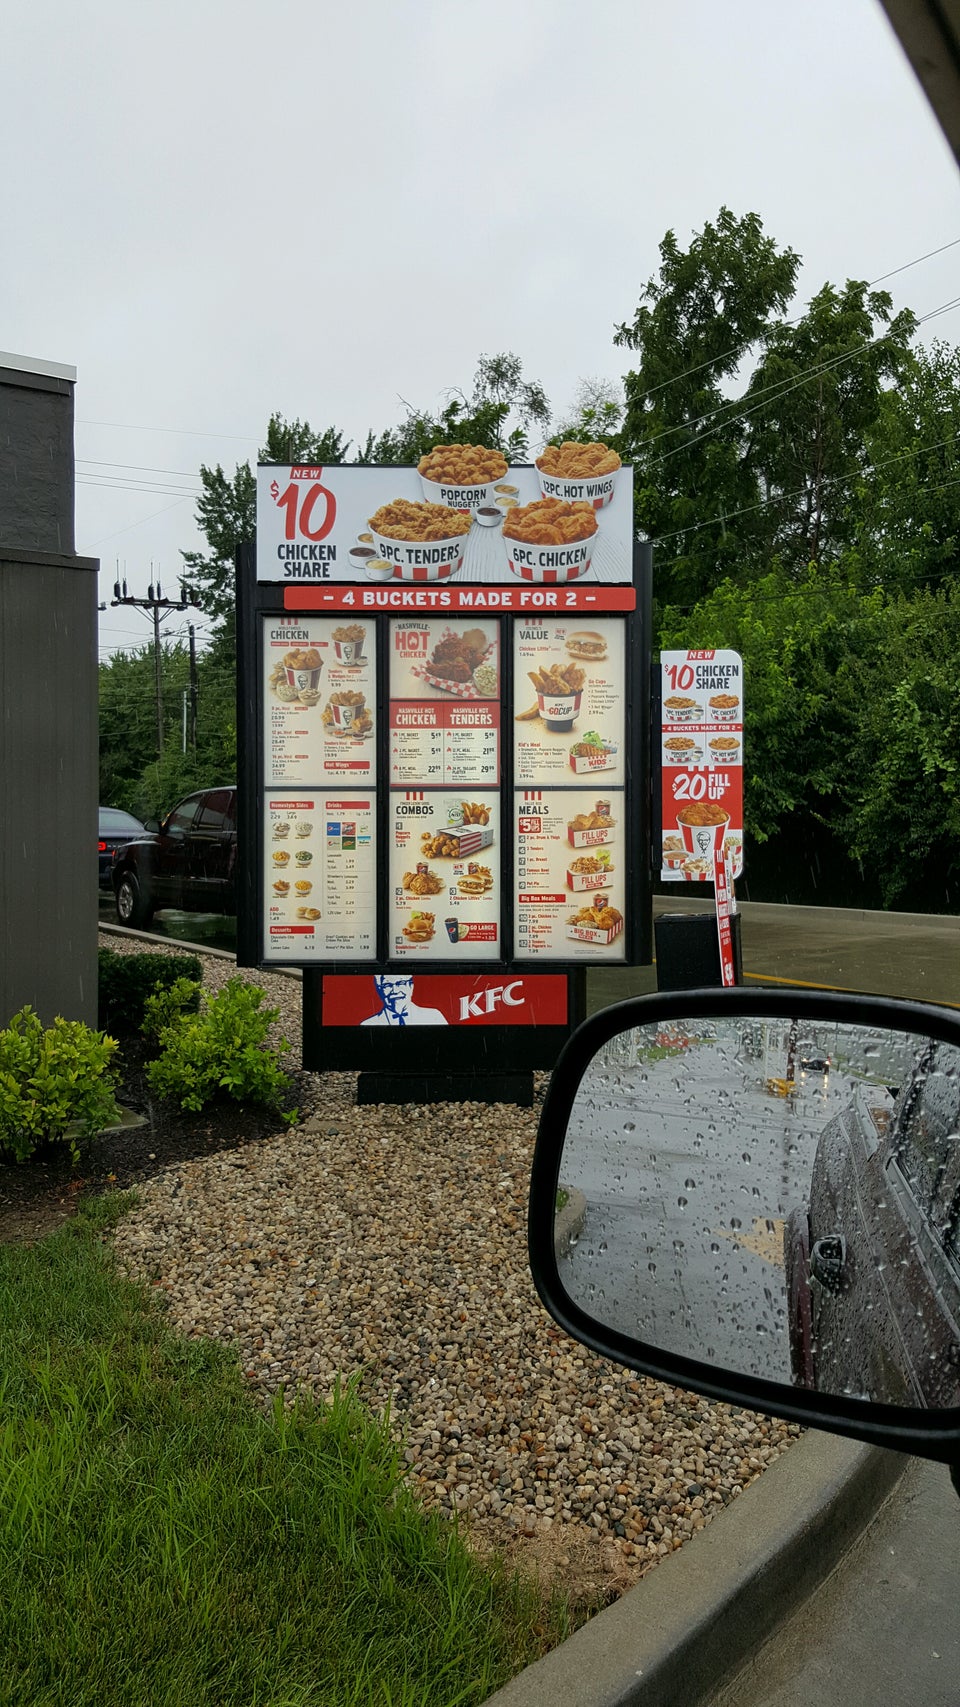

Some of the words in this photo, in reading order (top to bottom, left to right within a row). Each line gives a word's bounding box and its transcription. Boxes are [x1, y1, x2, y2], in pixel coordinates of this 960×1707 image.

[294, 468, 320, 479] NEW
[564, 484, 584, 498] HOT
[586, 479, 612, 496] WINGS
[441, 489, 486, 500] POPCORN
[447, 500, 480, 508] NUGGETS
[277, 545, 336, 561] CHICKEN
[406, 544, 459, 564] TENDERS
[539, 547, 587, 567] CHICKEN
[284, 562, 330, 578] SHARE
[342, 592, 356, 605] 4
[363, 593, 451, 606] BUCKETS
[460, 593, 512, 606] MADE
[521, 593, 556, 606] FOR
[562, 593, 577, 605] 2
[271, 631, 309, 639] CHICKEN
[519, 631, 548, 640] VALUE
[395, 632, 430, 650] HOT
[696, 665, 739, 676] CHICKEN
[696, 678, 729, 689] SHARE
[396, 714, 436, 725] CHICKEN
[450, 714, 492, 725] TENDERS
[708, 774, 731, 786] FILL
[708, 787, 725, 799] UP
[396, 806, 434, 815] COMBOS
[519, 806, 549, 814] MEALS
[582, 831, 595, 840] FILL
[596, 830, 608, 838] UPS
[582, 877, 595, 885] FILL
[586, 929, 597, 937] BOX
[459, 980, 525, 1021] KFC
